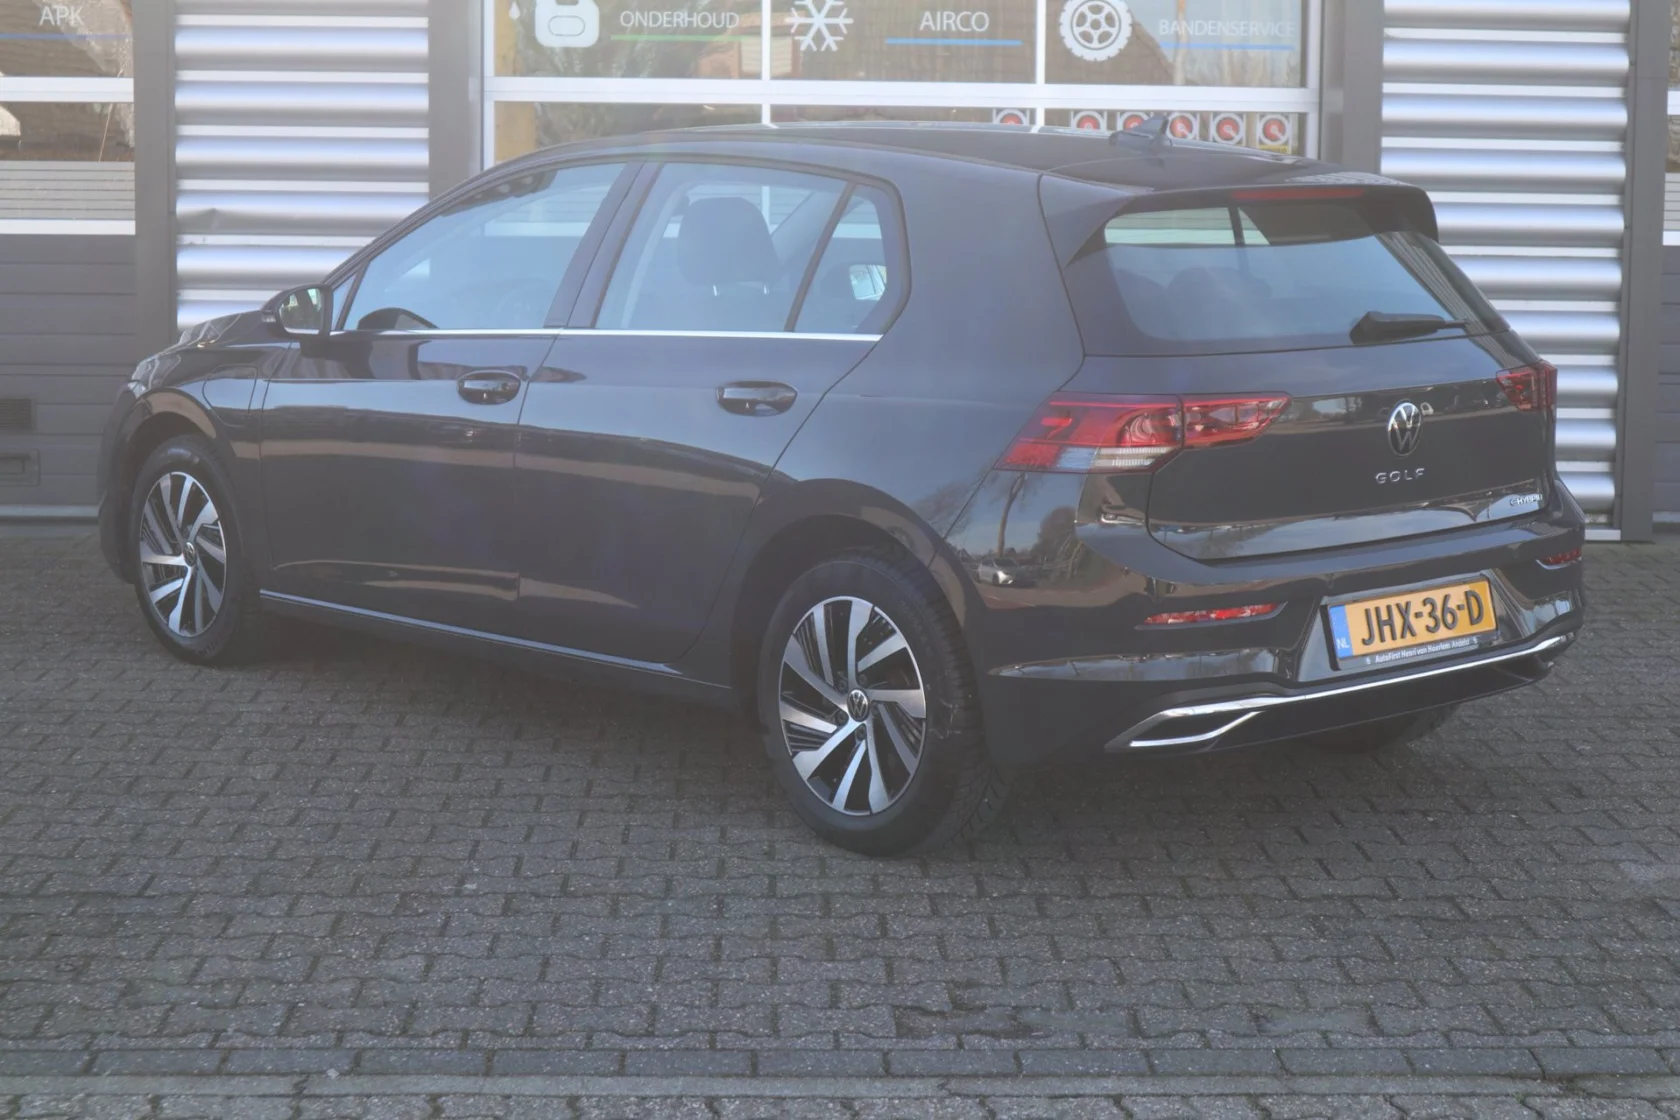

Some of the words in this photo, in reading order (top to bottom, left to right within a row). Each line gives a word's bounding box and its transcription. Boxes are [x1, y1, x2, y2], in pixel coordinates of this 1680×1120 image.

[39, 5, 85, 26] APK
[619, 10, 740, 29] ONDERHOUD
[919, 10, 990, 32] AIRCO
[1159, 19, 1296, 37] BANDENSERVICE
[1375, 467, 1425, 484] GOLF
[1361, 589, 1485, 646] JHX-36-D
[1336, 637, 1350, 650] NL
[1375, 652, 1401, 663] AutoFirst
